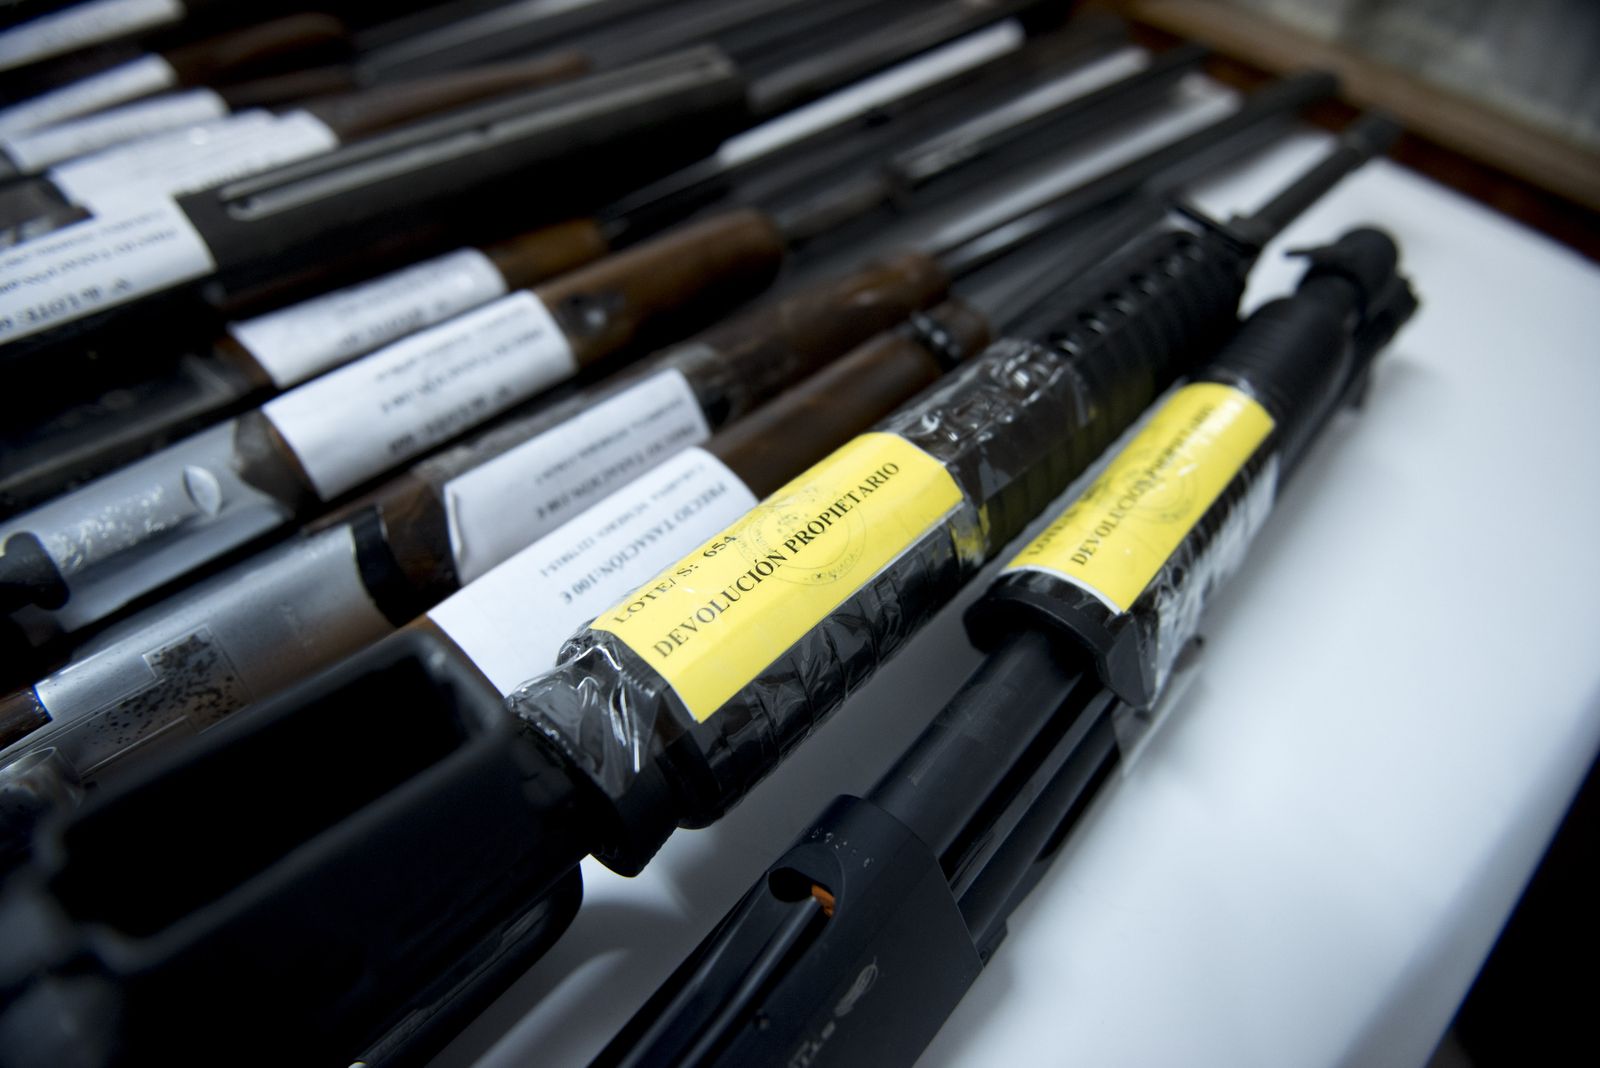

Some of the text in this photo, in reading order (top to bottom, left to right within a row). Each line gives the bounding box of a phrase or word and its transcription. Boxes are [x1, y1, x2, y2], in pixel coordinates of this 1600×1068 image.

[673, 480, 728, 523] PRECIO
[652, 461, 901, 659] DEVOLUCIÓN PROPIETARIO
[702, 534, 737, 559] 654
